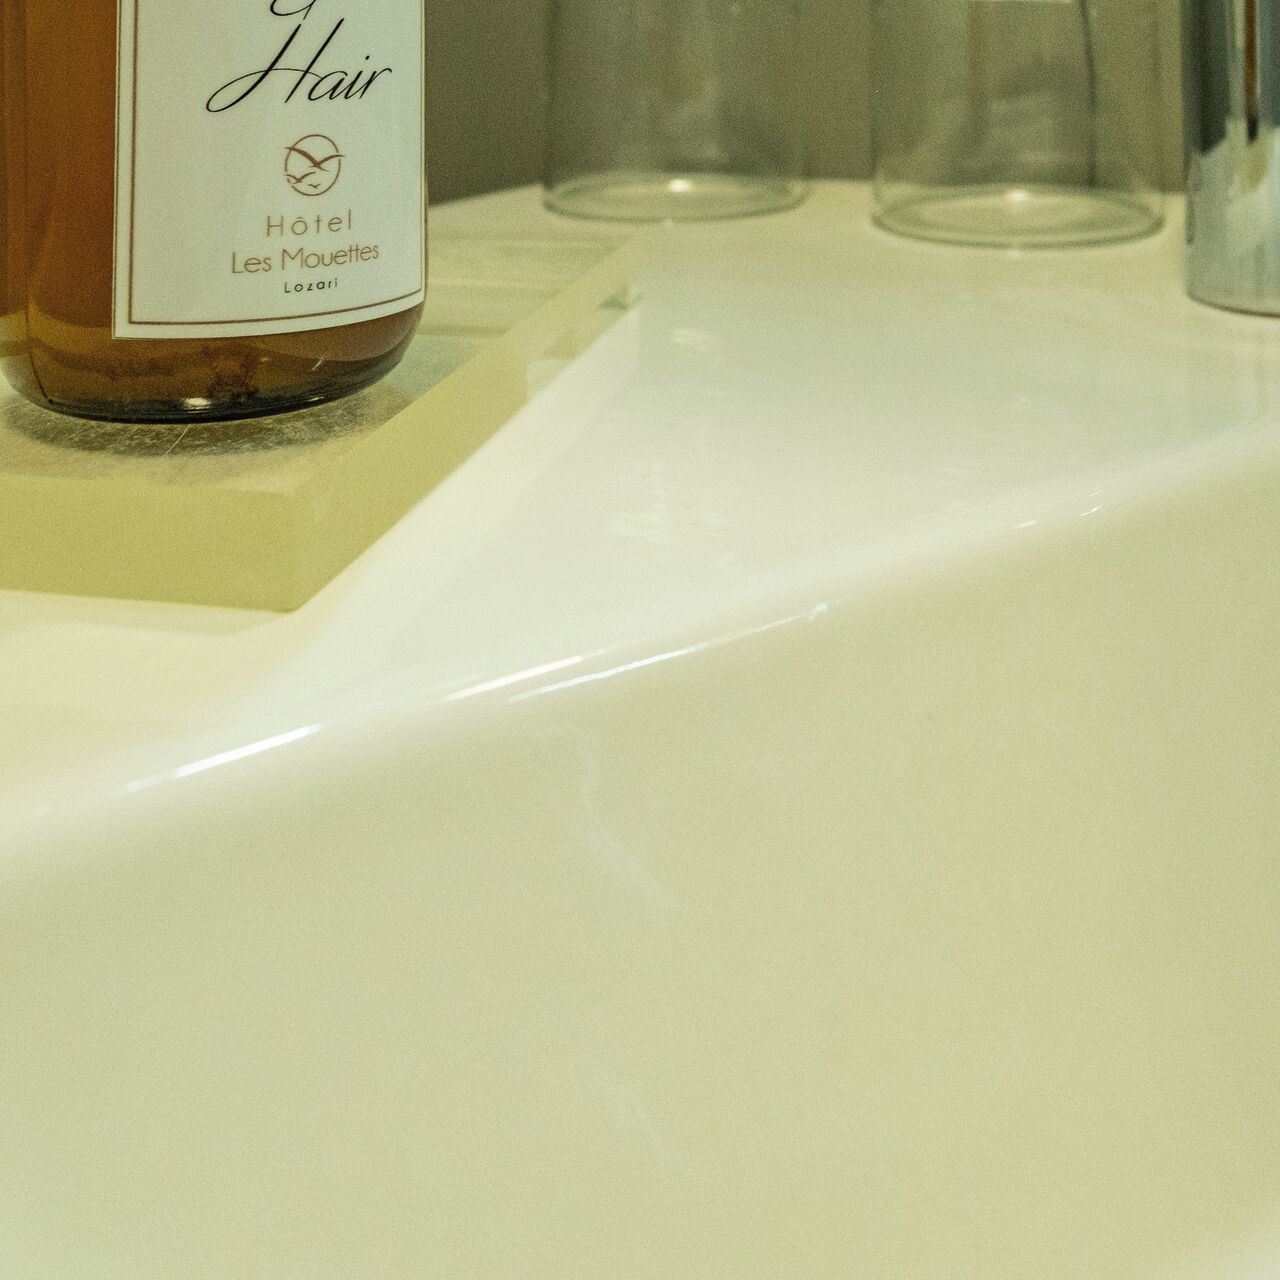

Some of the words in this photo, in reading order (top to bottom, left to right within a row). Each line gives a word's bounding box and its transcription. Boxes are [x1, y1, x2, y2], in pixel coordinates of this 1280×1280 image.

[205, 17, 393, 113] Hair
[266, 208, 352, 238] Hôtel
[231, 251, 273, 274] Les
[281, 243, 380, 271] Mouettes
[284, 277, 339, 294] Lozari
